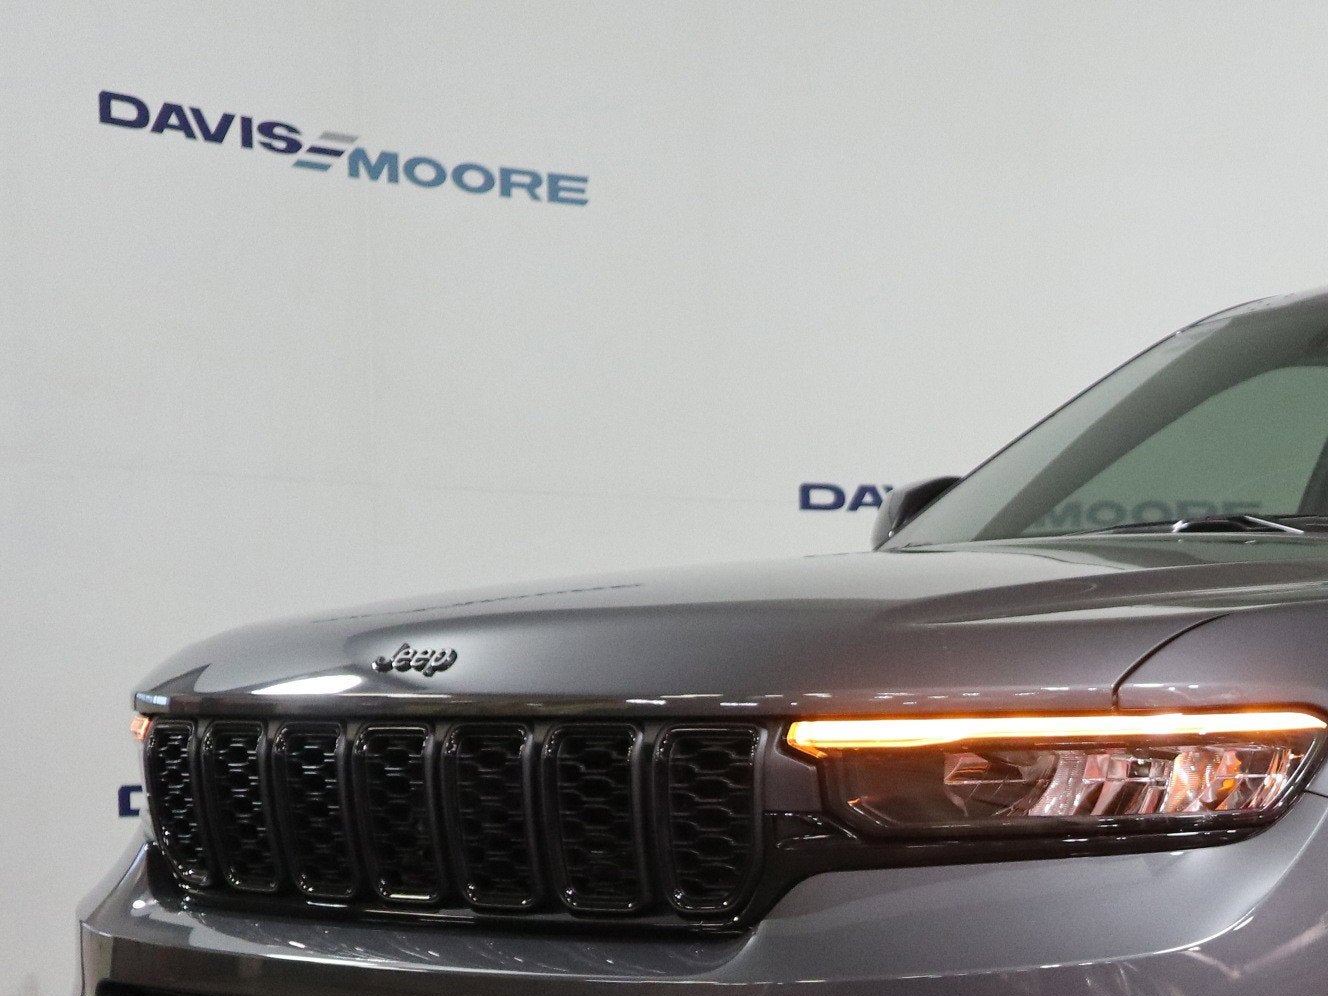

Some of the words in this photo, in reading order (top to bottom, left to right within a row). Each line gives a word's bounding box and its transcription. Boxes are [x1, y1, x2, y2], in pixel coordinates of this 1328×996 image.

[98, 90, 303, 154] DAVIS
[347, 147, 589, 206] MOORE
[799, 483, 893, 512] DA
[371, 642, 458, 678] Jeep
